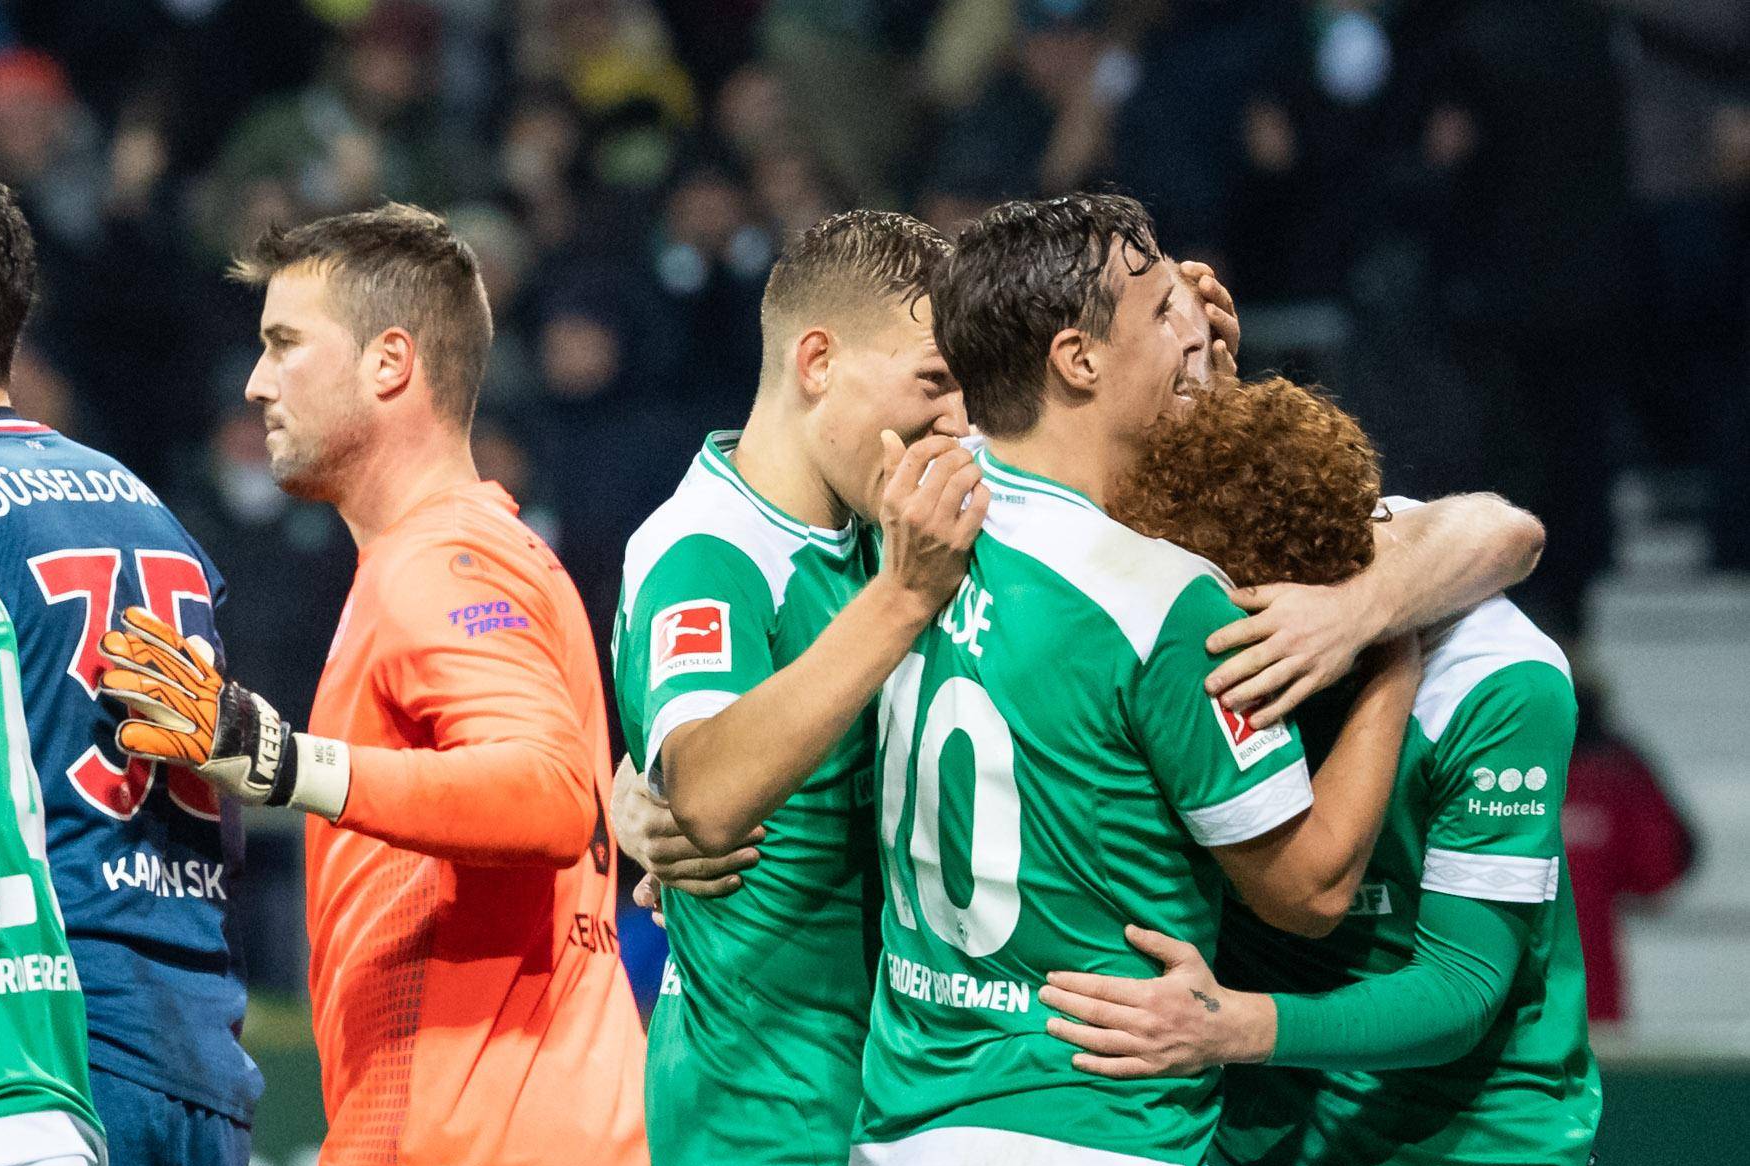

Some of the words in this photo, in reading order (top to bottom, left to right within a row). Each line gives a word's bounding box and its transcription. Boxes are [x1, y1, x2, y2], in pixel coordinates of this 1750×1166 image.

[448, 601, 510, 625] TOYO
[464, 616, 530, 639] TIRES
[1467, 798, 1546, 817] H-Hotels
